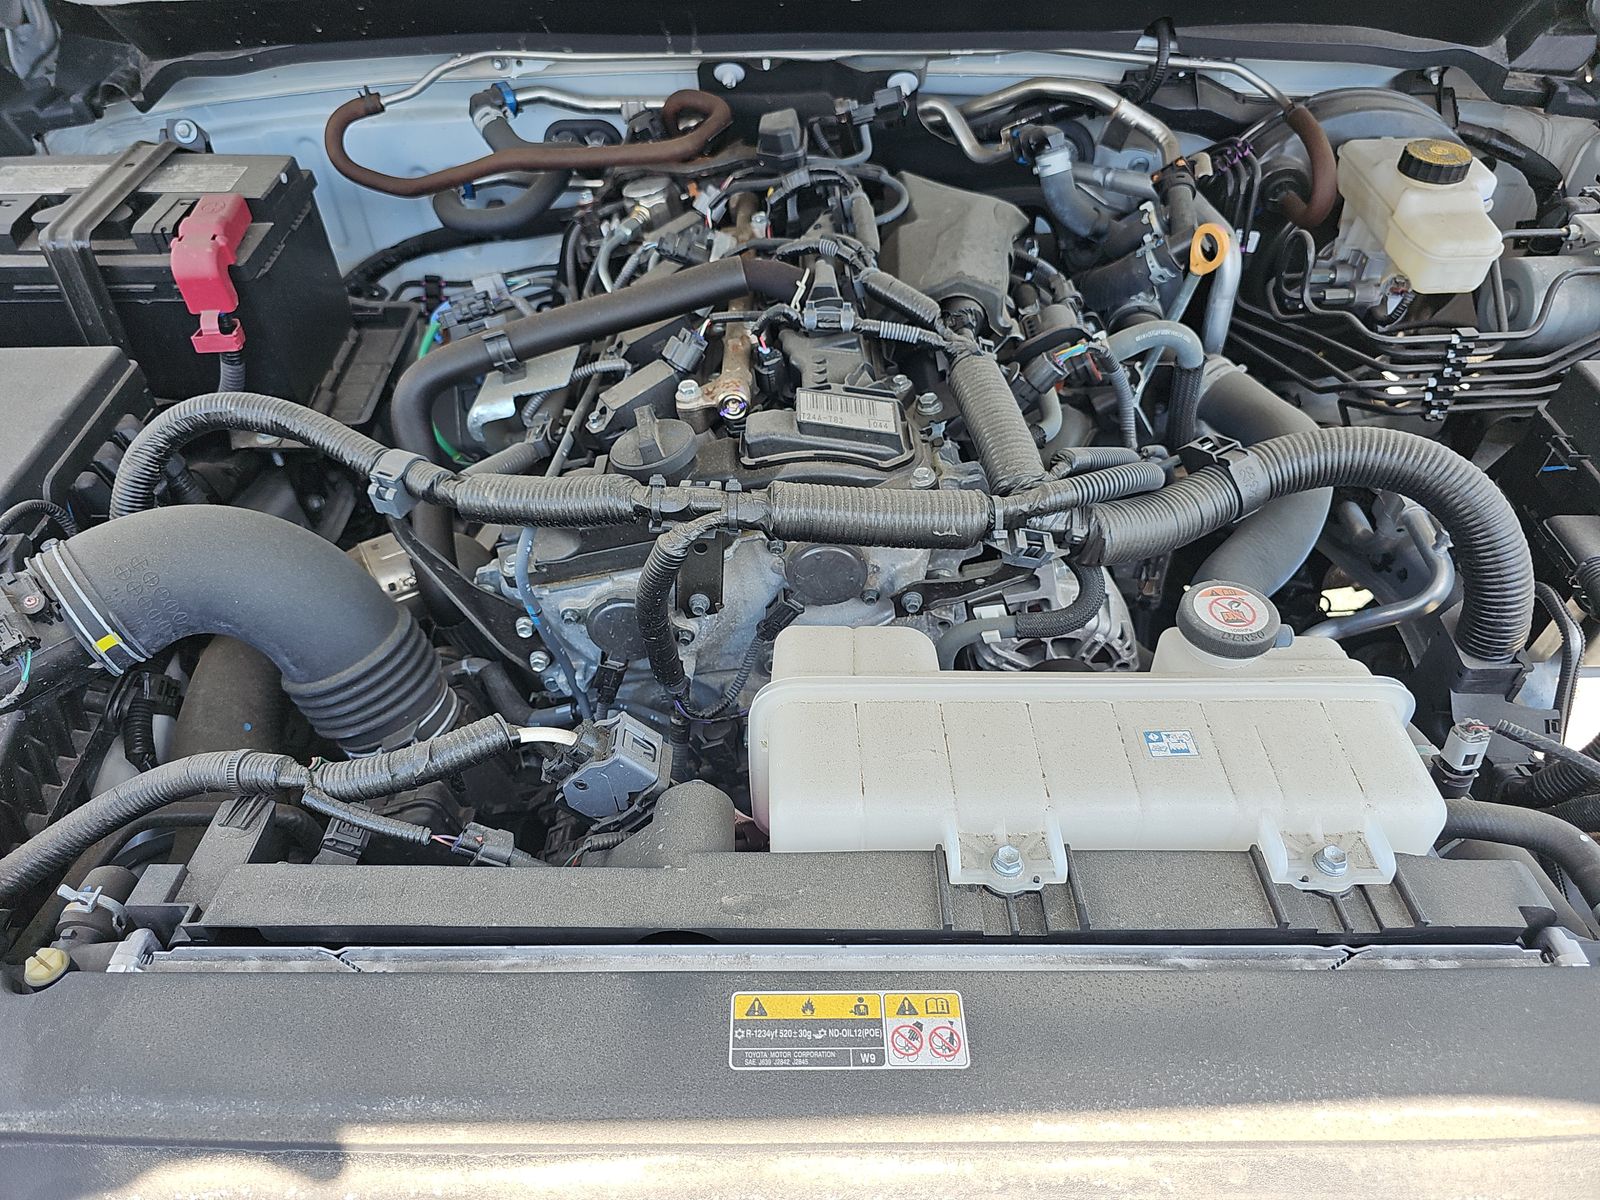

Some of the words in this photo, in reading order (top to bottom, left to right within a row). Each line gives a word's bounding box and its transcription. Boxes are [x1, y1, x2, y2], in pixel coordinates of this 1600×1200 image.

[745, 1028, 777, 1040] R-1234yf
[778, 1028, 812, 1040] 520±30g
[828, 1028, 882, 1038] ND-OIL12(POE)
[794, 1051, 836, 1059] CORPORATION
[860, 1053, 876, 1063] W9
